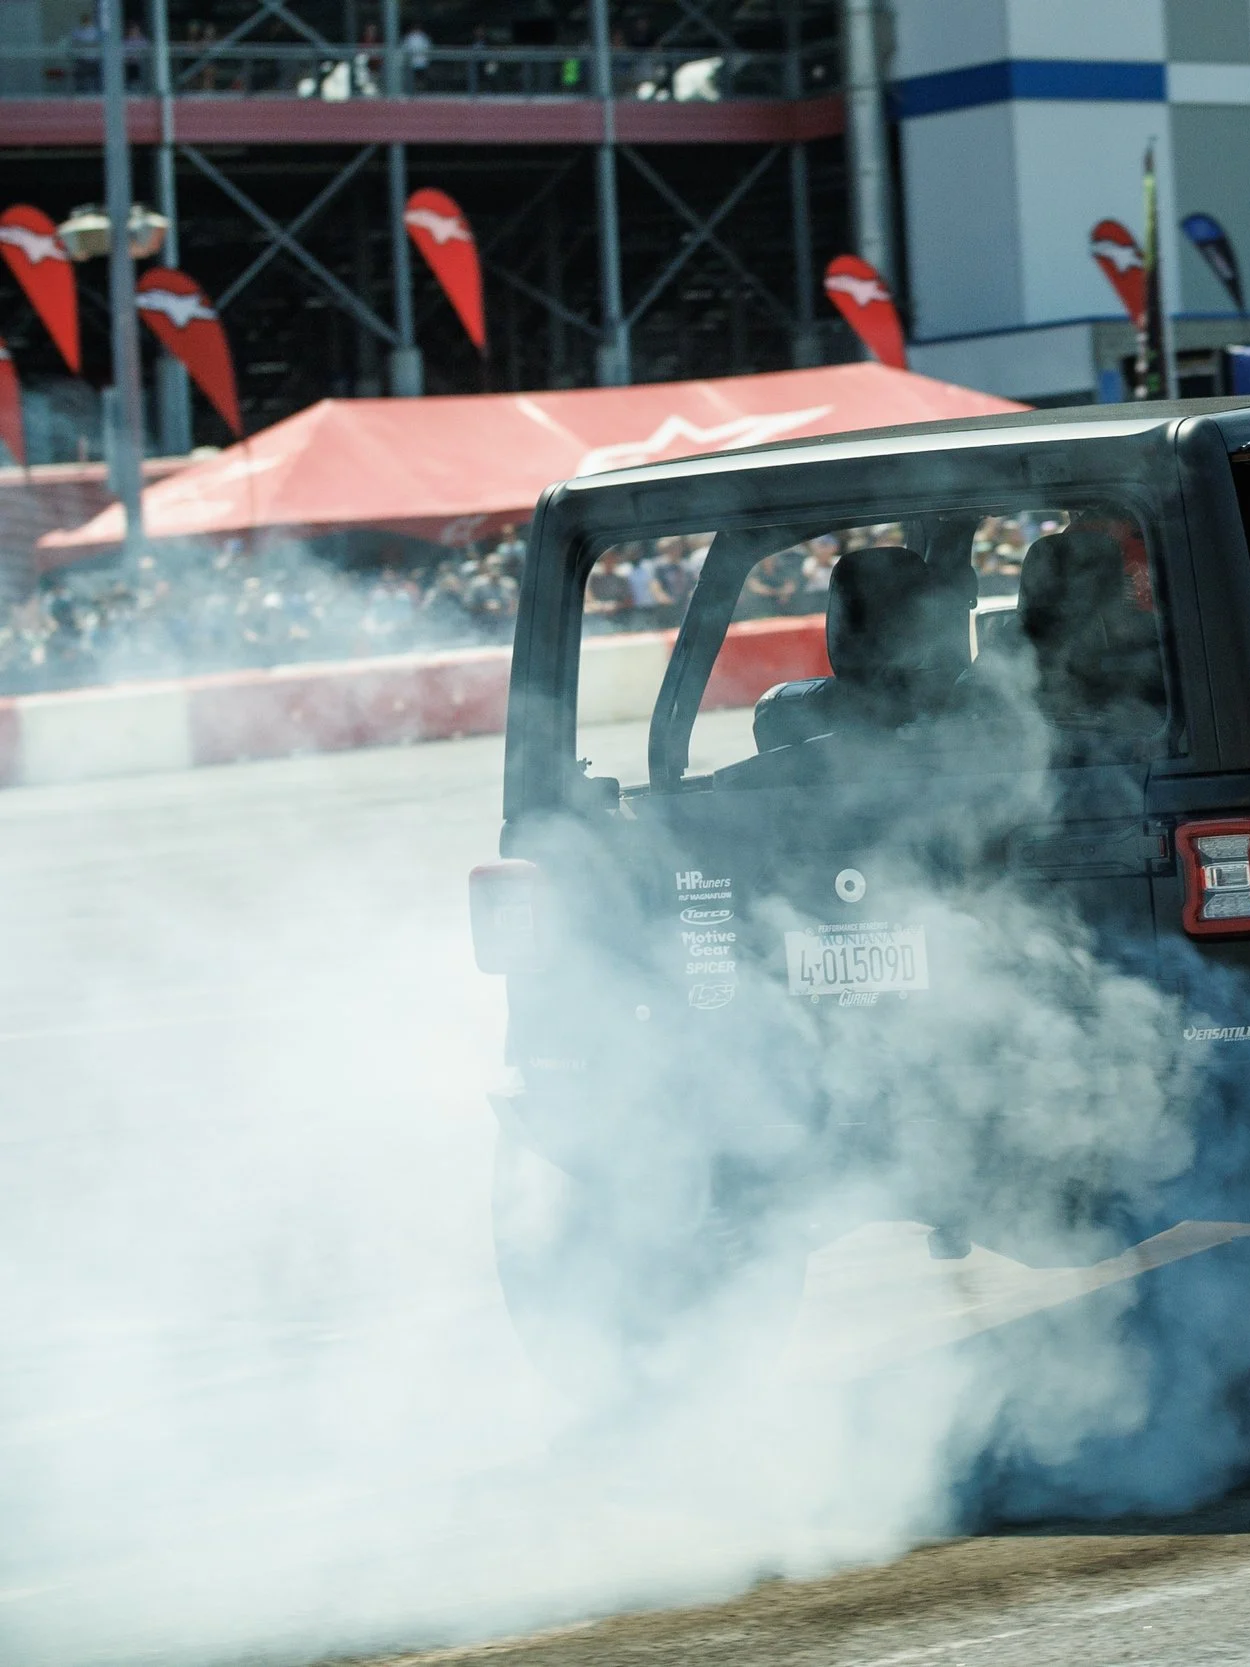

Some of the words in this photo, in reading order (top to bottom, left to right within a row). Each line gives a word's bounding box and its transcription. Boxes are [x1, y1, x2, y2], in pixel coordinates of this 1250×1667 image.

[686, 909, 730, 918] Torco
[681, 930, 736, 945] Motive
[819, 933, 894, 946] MONTANA
[689, 944, 730, 957] Gear
[685, 960, 736, 975] SPICER
[839, 989, 880, 1006] CURRIE
